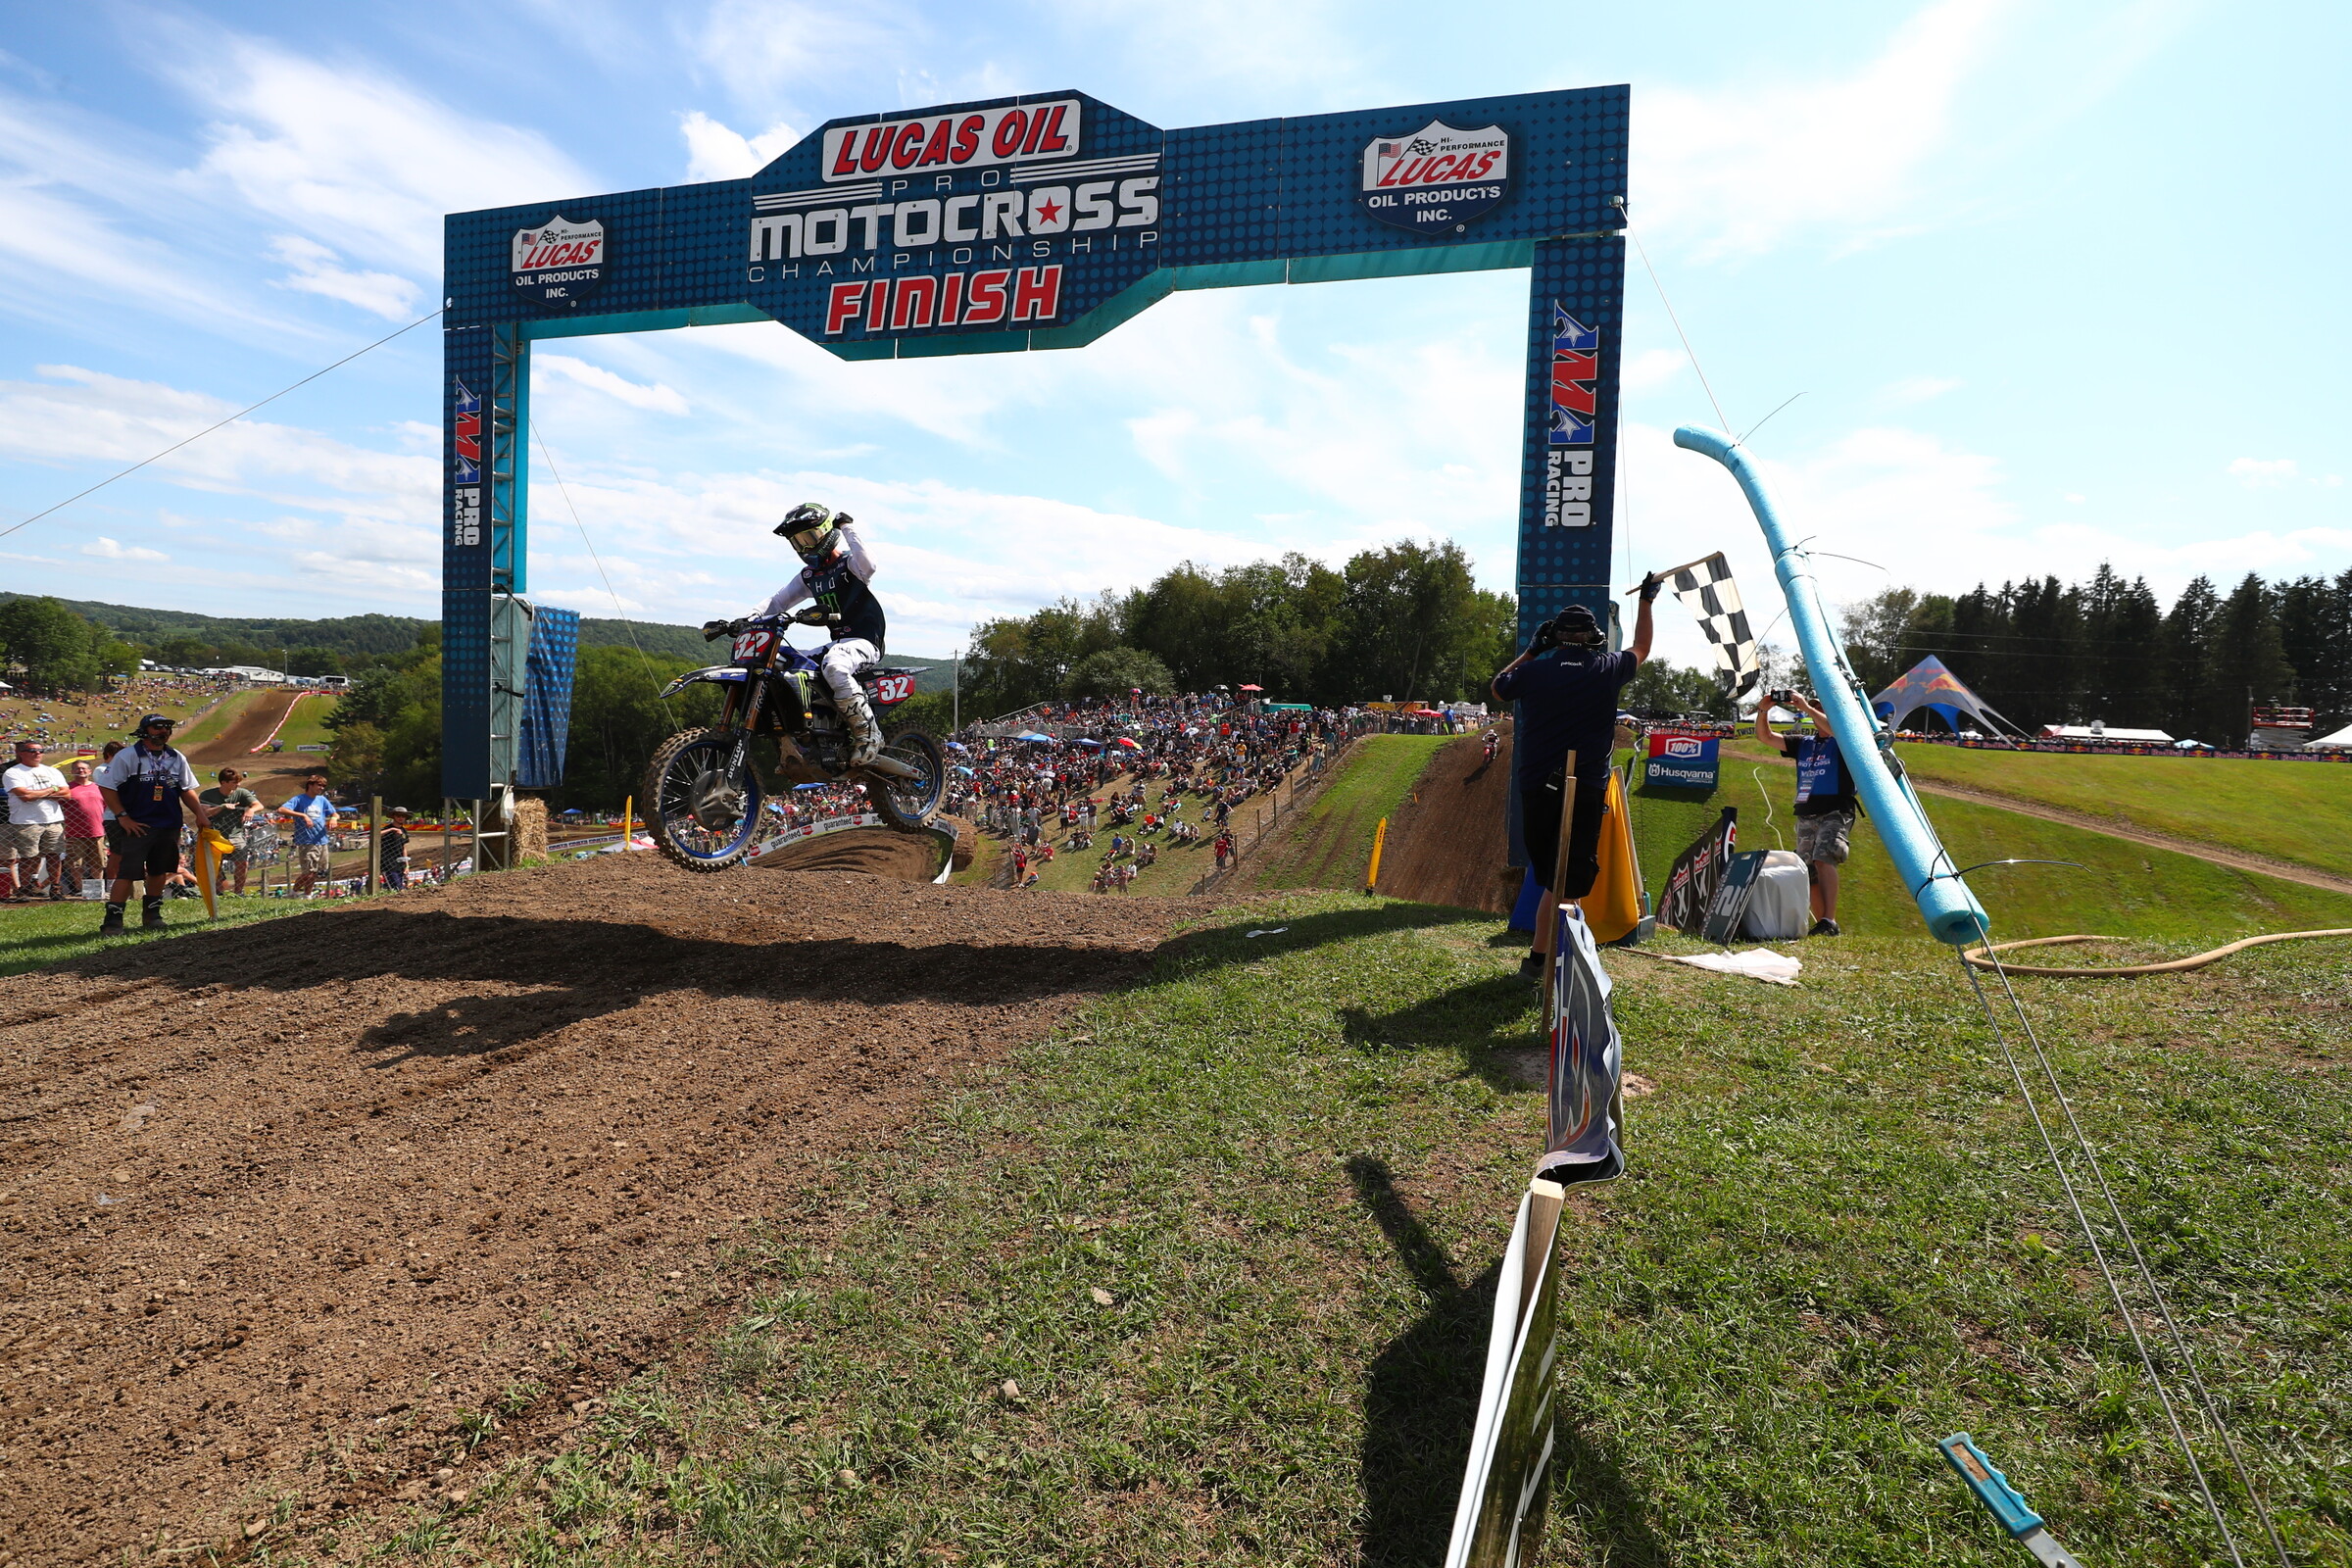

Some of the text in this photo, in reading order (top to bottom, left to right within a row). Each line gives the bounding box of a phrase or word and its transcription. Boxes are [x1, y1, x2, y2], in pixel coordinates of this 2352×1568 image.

[831, 105, 1070, 177] LUCAS OIL
[1440, 139, 1505, 152] PERFORMANCE
[891, 169, 1001, 197] PRO
[1377, 150, 1502, 187] LUCAS
[1368, 184, 1501, 209] OIL PRODUCTS
[749, 175, 1160, 263] MOTOCROSS
[1416, 208, 1452, 223] INC.
[560, 230, 602, 241] PERFORMANCE
[520, 239, 601, 270] LUCAS
[748, 230, 1158, 283] CHAMPIONSHIP
[514, 269, 600, 287] OIL PRODUCTS
[545, 287, 568, 299] INC.
[824, 263, 1063, 336] FINISH
[1544, 450, 1562, 528] RACING
[1560, 450, 1593, 528] PRO
[455, 488, 464, 547] RACING
[464, 487, 480, 546] PRO
[734, 631, 770, 661] 32
[880, 676, 908, 701] 32
[727, 739, 743, 779] DUNLOP
[1670, 743, 1697, 754] 100%
[1661, 767, 1714, 779] Husqvarna
[823, 817, 853, 831] guaranteed
[770, 829, 802, 850] guaranteed
